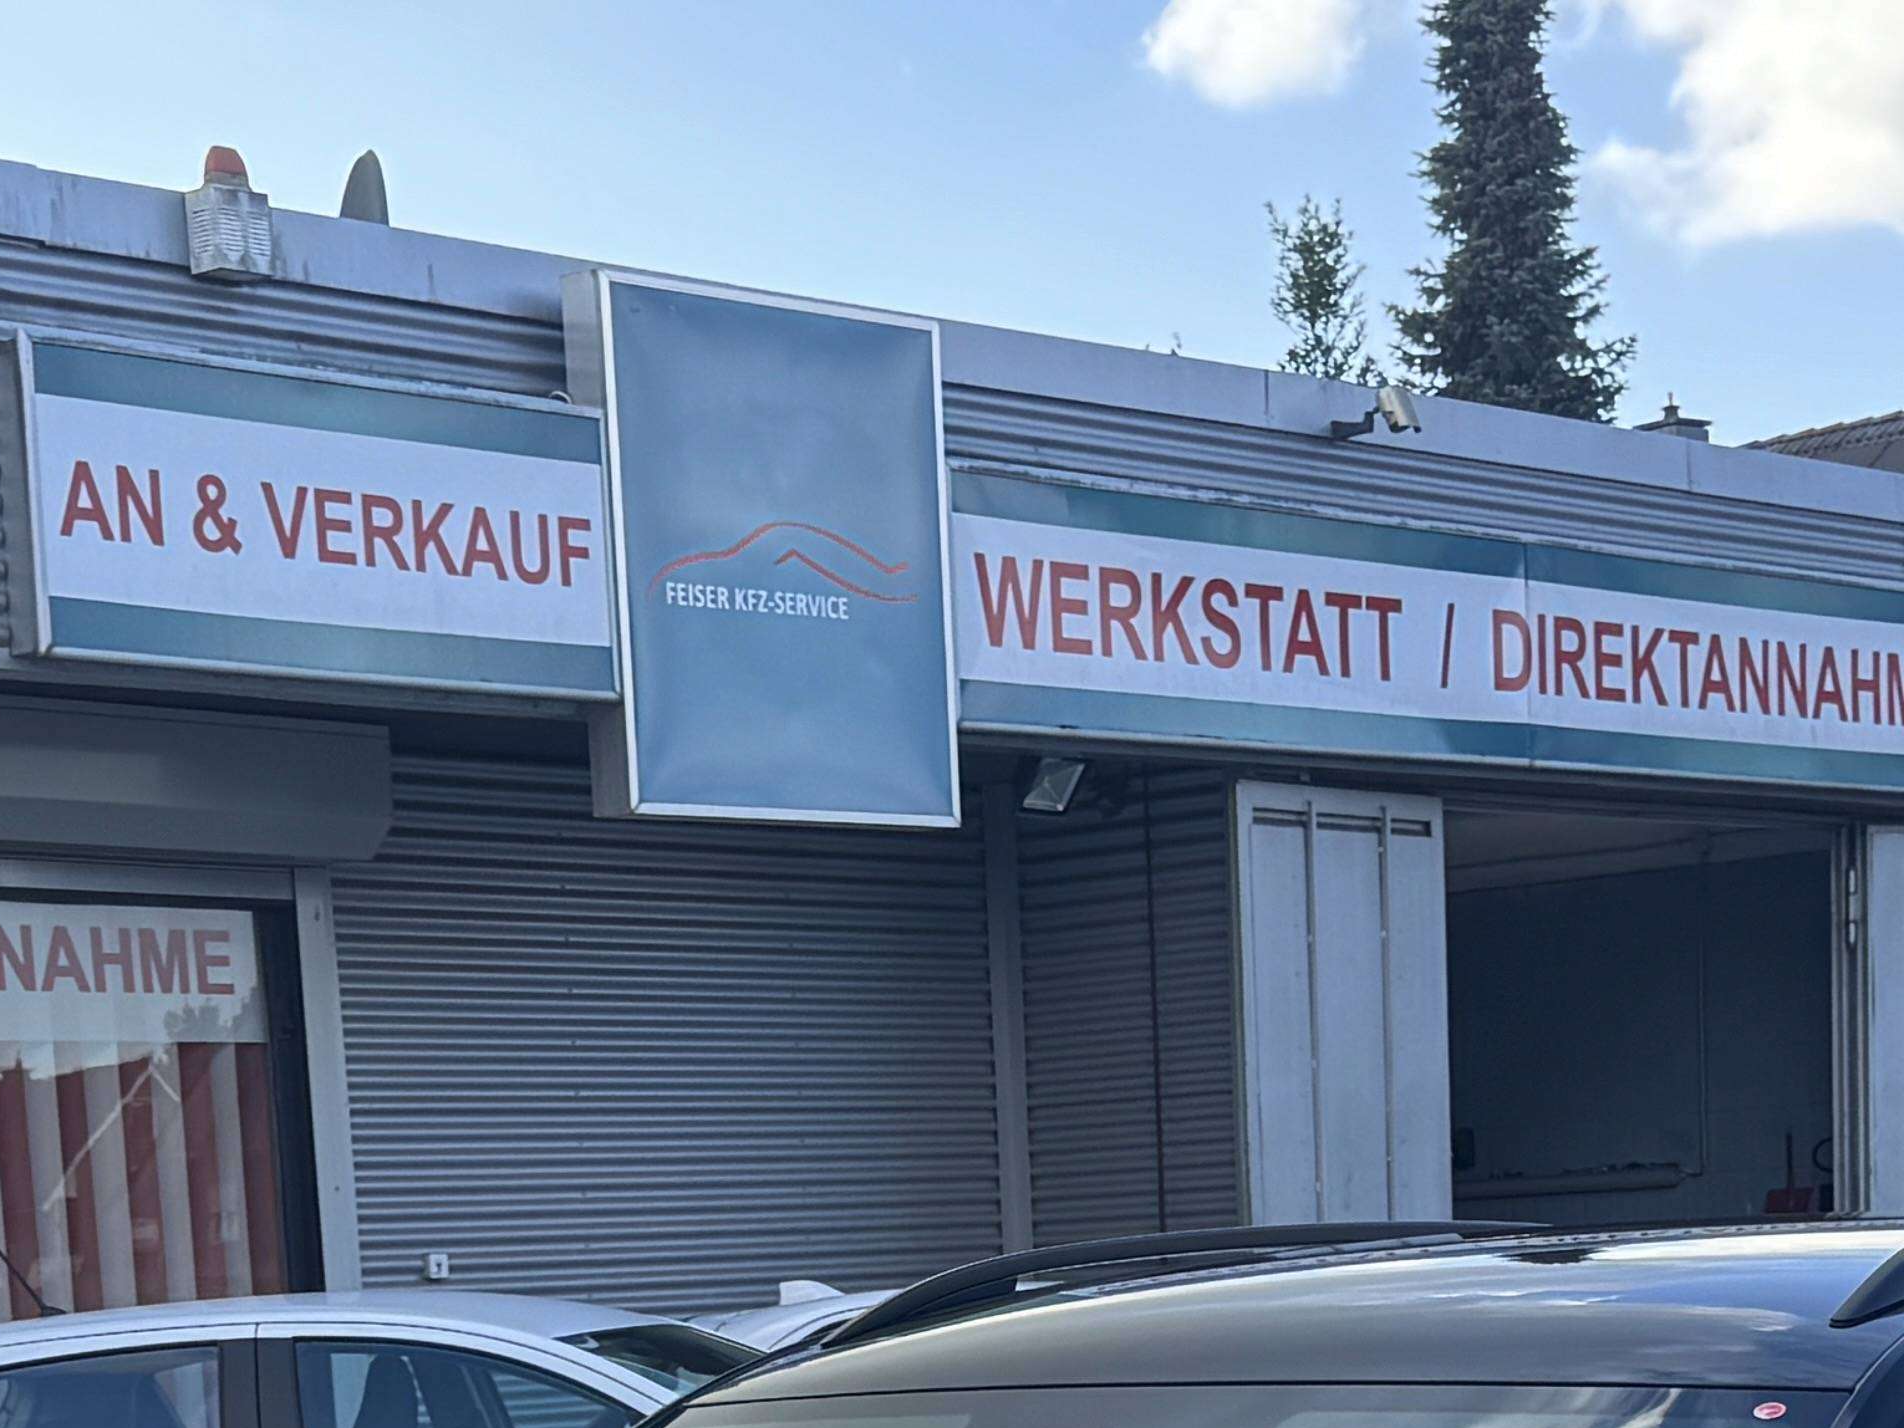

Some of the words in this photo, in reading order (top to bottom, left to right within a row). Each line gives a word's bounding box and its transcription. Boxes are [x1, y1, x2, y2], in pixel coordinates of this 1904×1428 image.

[59, 460, 164, 546] AN
[192, 473, 242, 556] &
[259, 481, 592, 587] VERKAUF
[665, 581, 730, 610] FEISER
[734, 587, 850, 620] KFZ-SERVICE
[973, 551, 1403, 682] WERKSTATT
[1440, 601, 1455, 689] /
